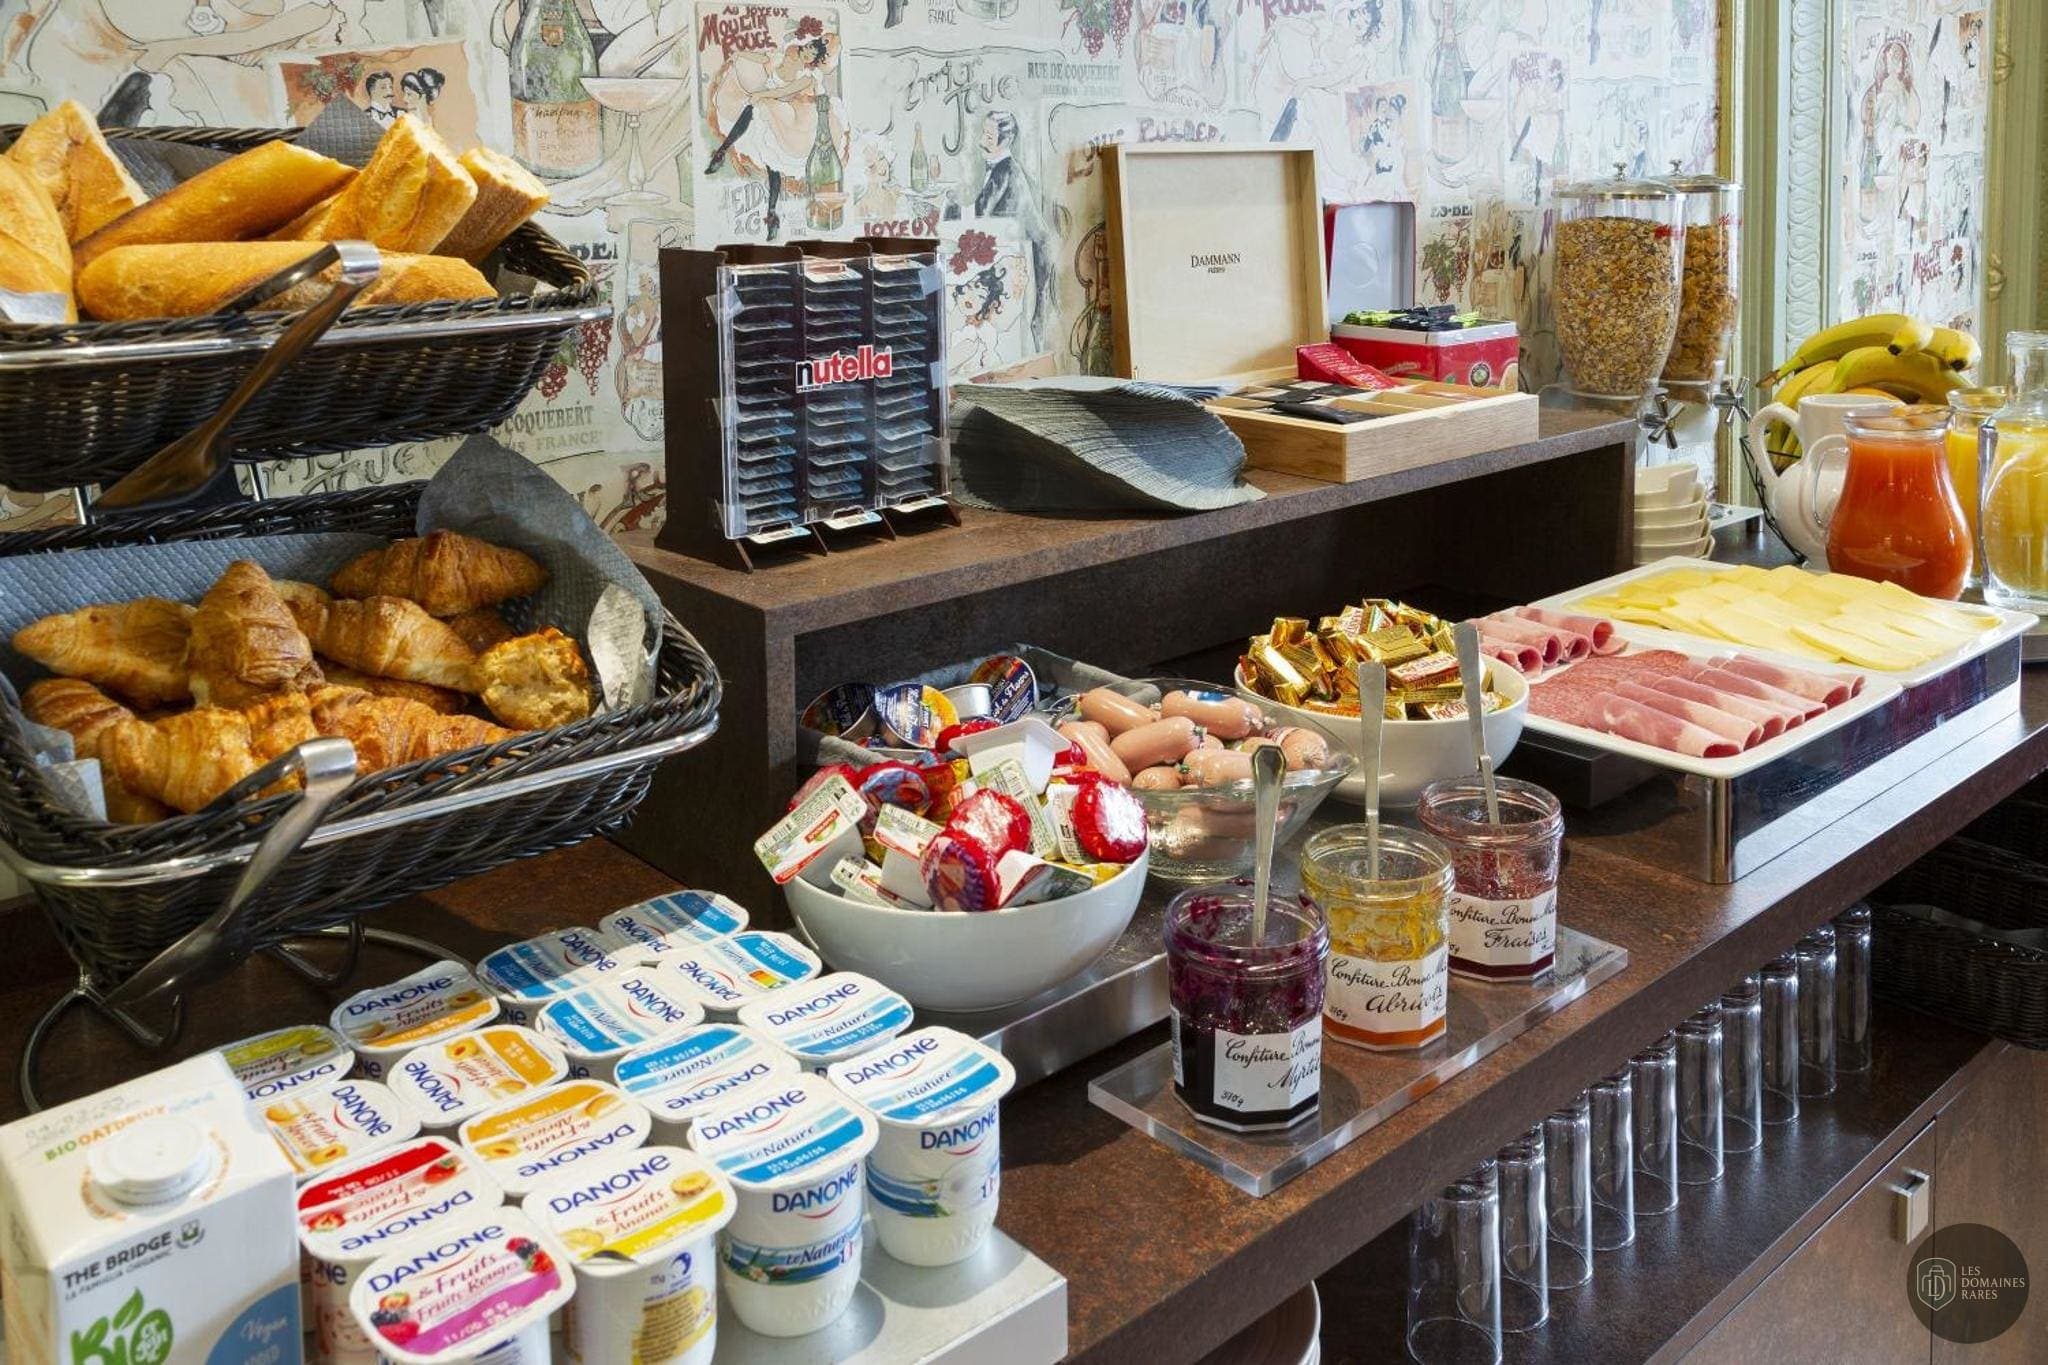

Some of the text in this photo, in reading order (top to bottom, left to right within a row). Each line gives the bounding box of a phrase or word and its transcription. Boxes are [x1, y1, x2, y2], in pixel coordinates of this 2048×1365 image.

[1191, 253, 1241, 268] DAMMANN
[796, 344, 892, 387] nutella
[560, 932, 618, 972] DANONE
[614, 916, 672, 953] DANONE
[679, 960, 742, 1001] DANONE
[1331, 958, 1388, 988] Confiture
[347, 976, 454, 1017] DANONE
[622, 979, 685, 1023] DANONE
[767, 982, 861, 1026] DANONE
[844, 1037, 939, 1085] DANONE
[1224, 1038, 1290, 1068] Confiture
[405, 1061, 464, 1112] DANONE
[665, 1063, 771, 1110] DANONE
[332, 1085, 392, 1137] DANONE
[701, 1088, 807, 1140] DANONE
[920, 1104, 998, 1149] DANONE
[517, 1124, 636, 1177] DANONE
[549, 1154, 671, 1213] DANONE
[773, 1163, 858, 1213] DANONE
[340, 1190, 475, 1252] DANONE
[63, 1231, 173, 1290] THE BRIDGE
[368, 1225, 505, 1293] DANONE
